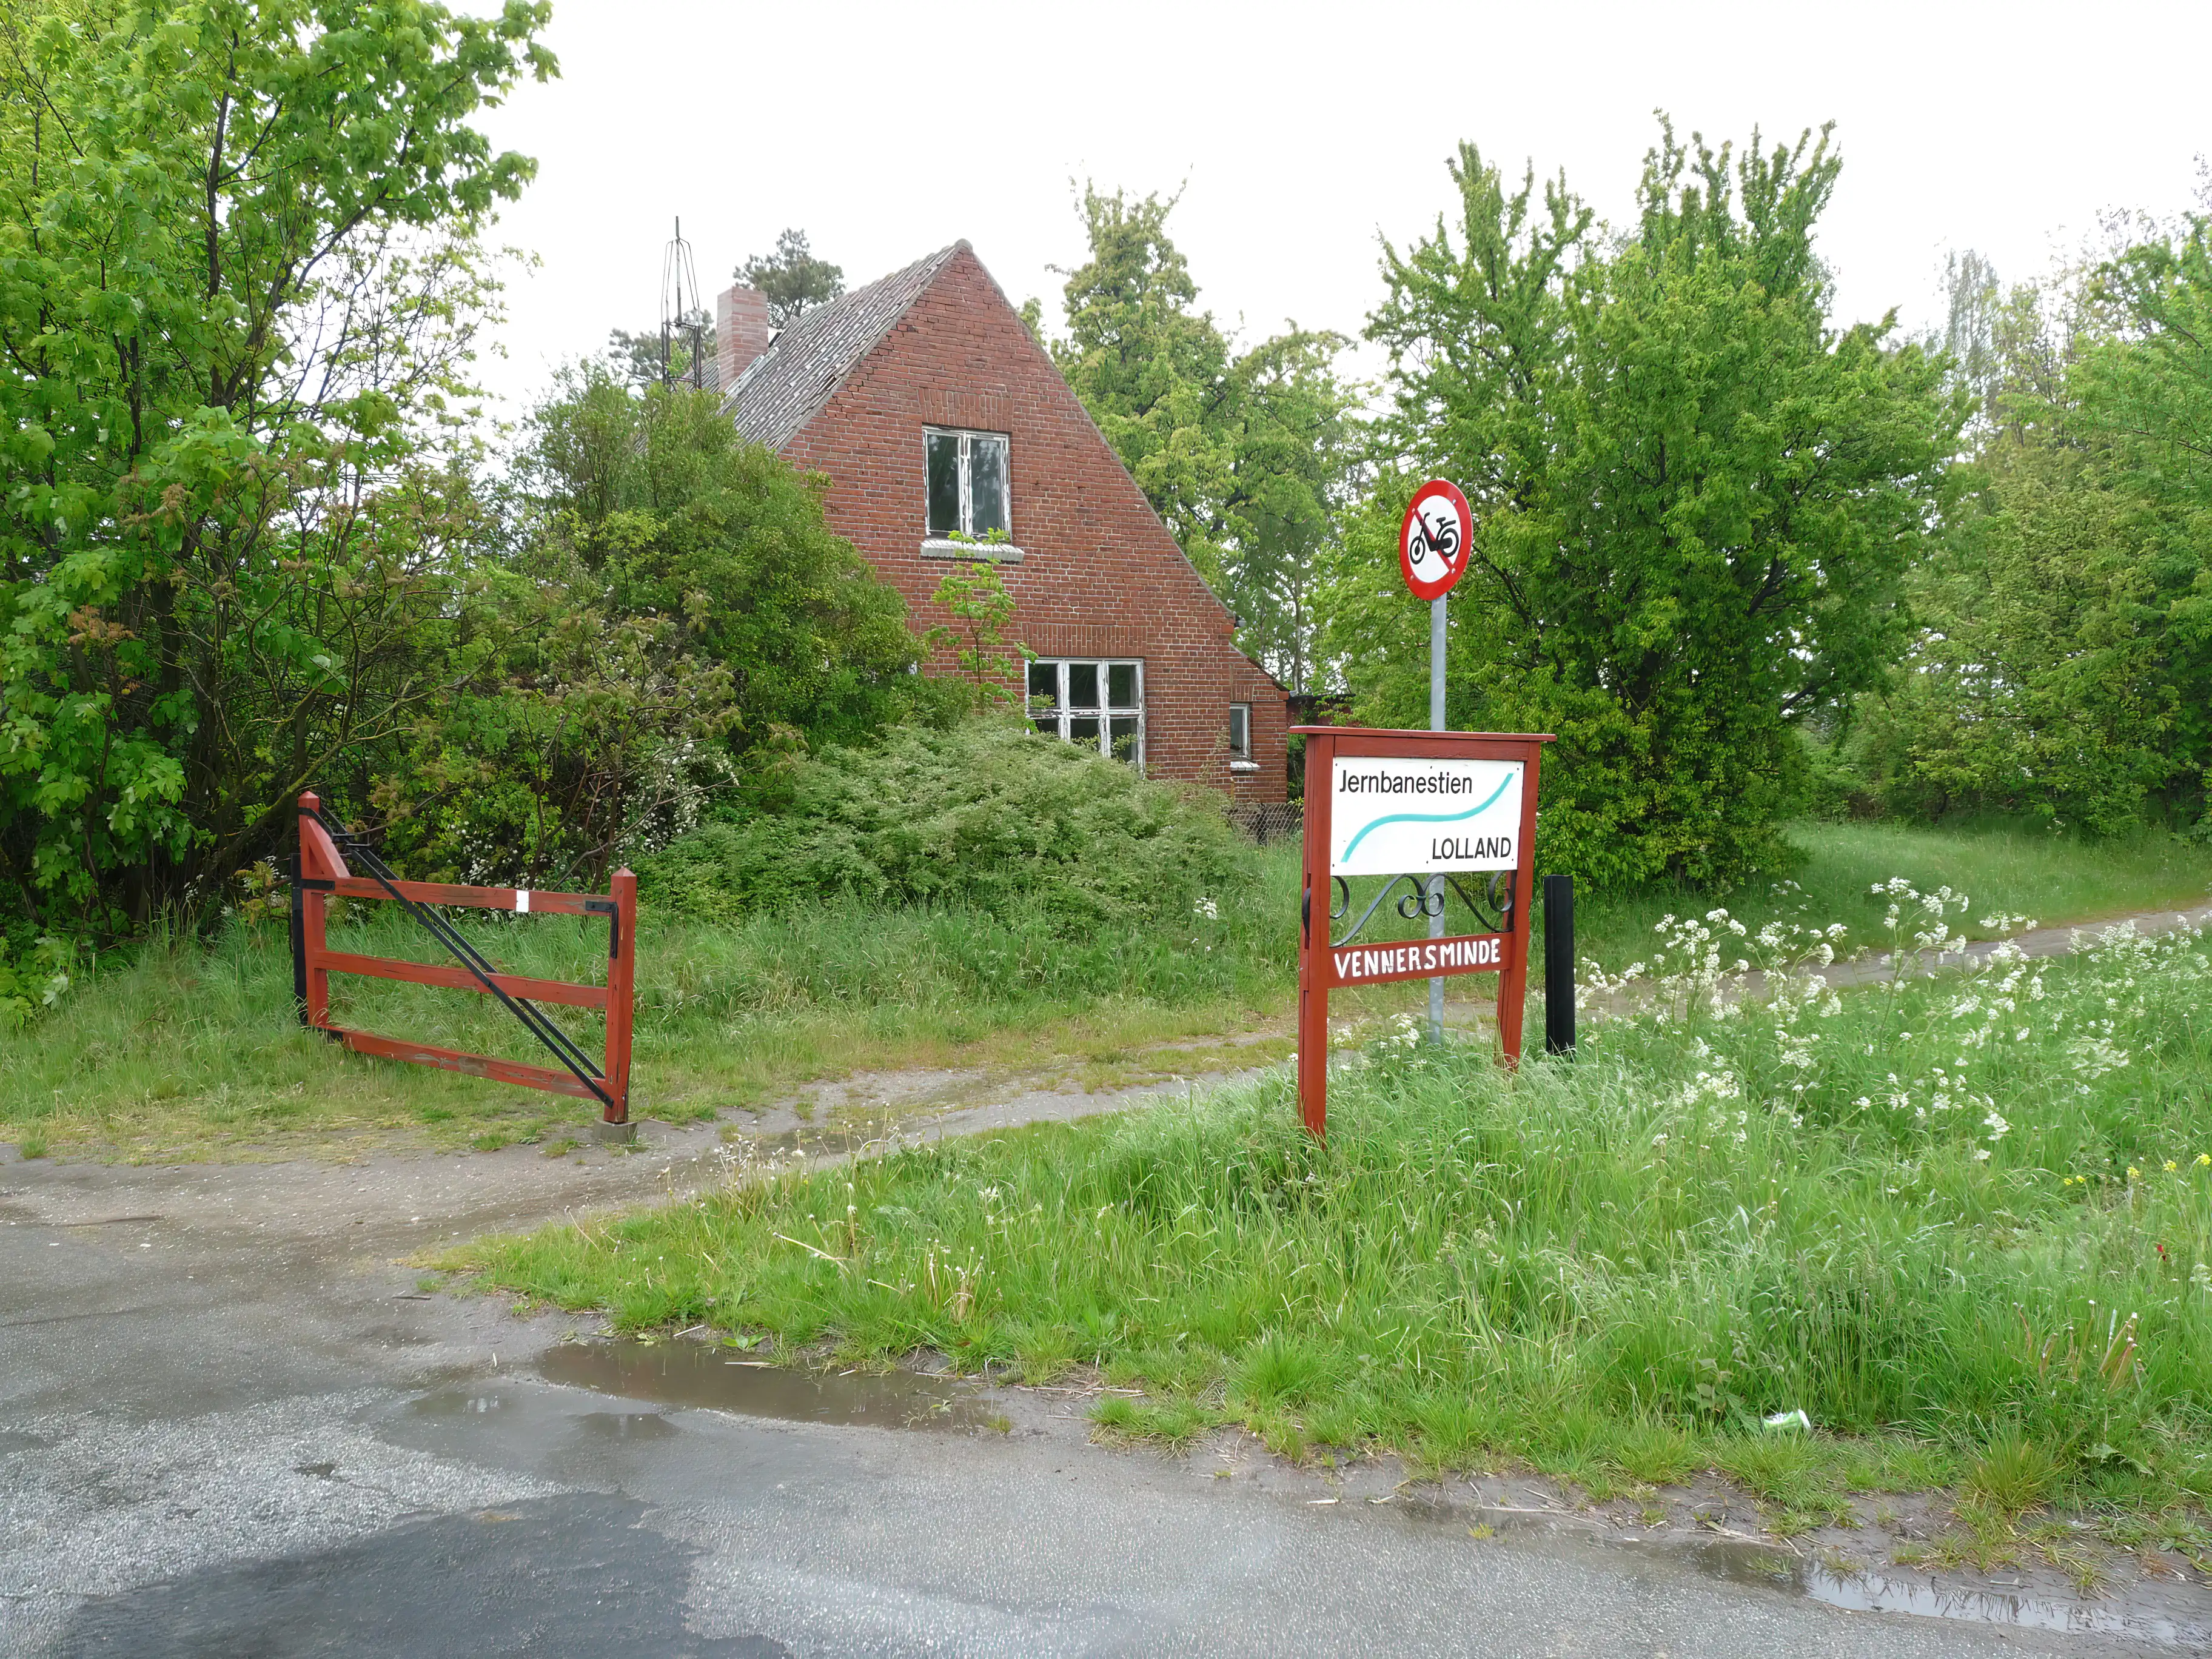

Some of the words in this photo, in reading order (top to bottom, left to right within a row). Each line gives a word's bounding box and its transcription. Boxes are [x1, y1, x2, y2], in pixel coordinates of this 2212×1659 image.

[1339, 769, 1473, 794] Jernbanestien
[1432, 837, 1512, 860] LOLLAND
[1334, 938, 1501, 979] VENNERSMINDE
